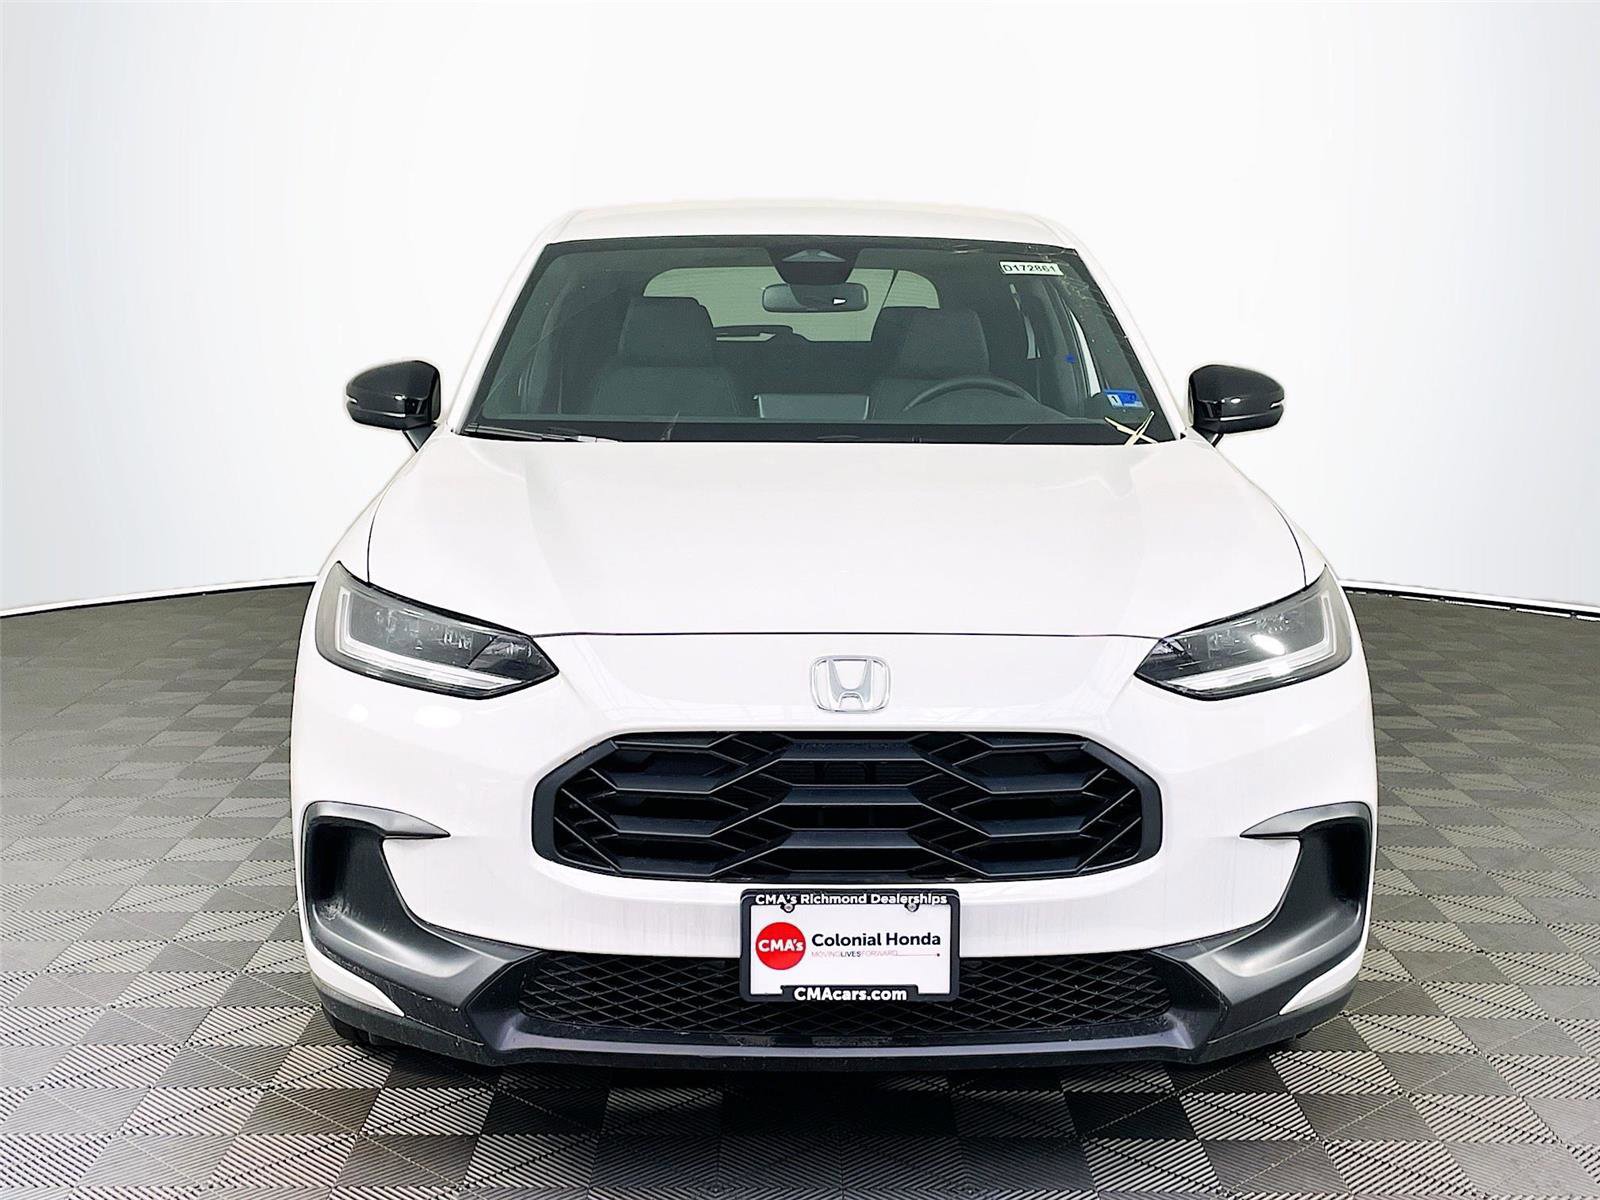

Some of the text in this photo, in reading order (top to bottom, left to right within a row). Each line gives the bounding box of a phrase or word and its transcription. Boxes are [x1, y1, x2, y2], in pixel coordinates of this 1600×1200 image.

[755, 893, 948, 905] CMA's Richmond Dealerships
[757, 939, 804, 952] CMA's
[811, 932, 941, 947] Colonial Honda
[793, 987, 907, 1001] CMAcars.com
